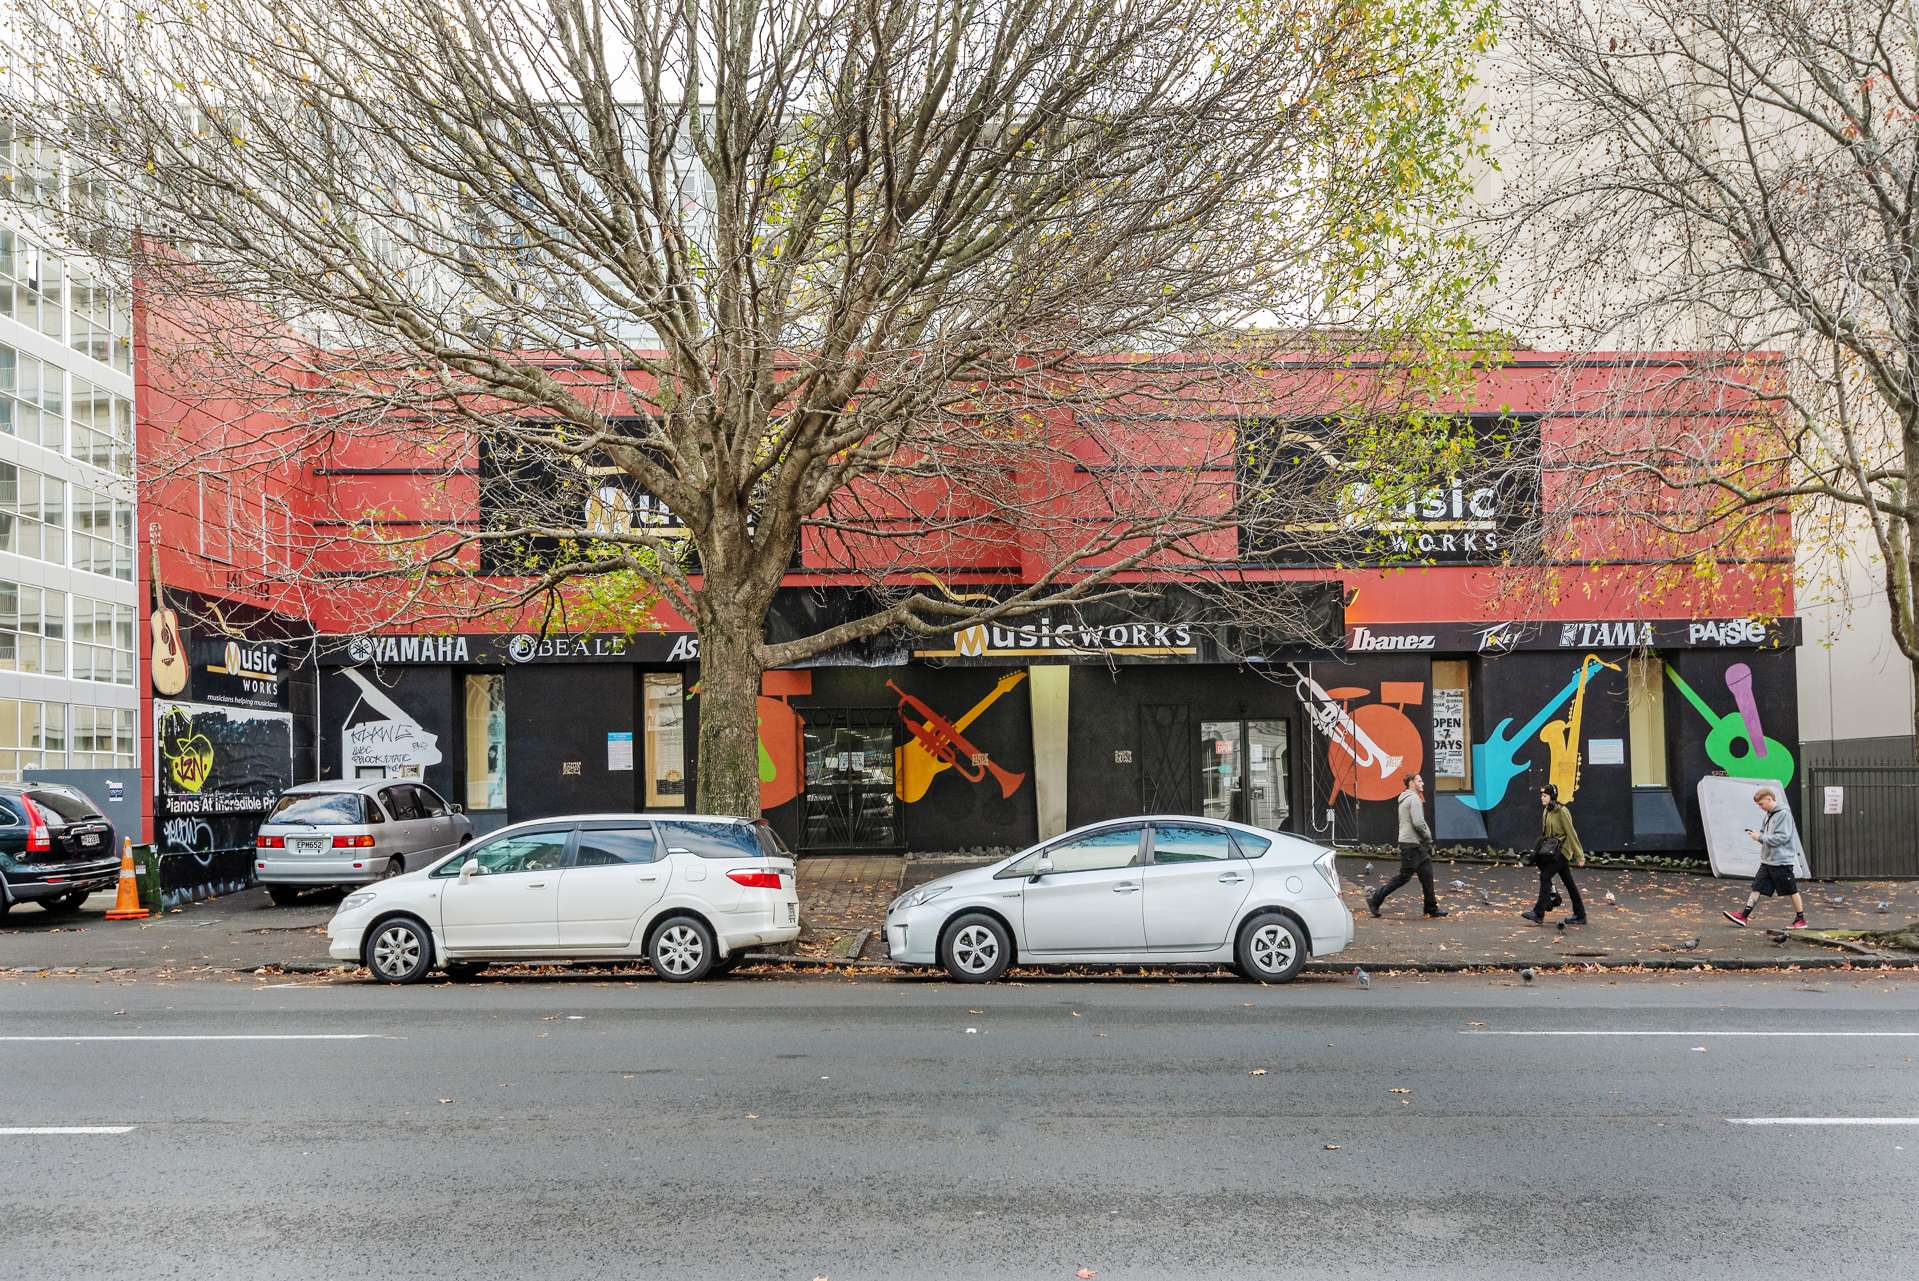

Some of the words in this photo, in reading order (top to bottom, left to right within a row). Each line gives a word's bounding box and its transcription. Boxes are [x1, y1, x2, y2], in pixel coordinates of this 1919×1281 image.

[1391, 533, 1498, 552] WORKS
[954, 617, 1074, 656] Music
[1079, 624, 1191, 647] WORKS
[1349, 627, 1436, 651] Ibanez
[1578, 622, 1654, 647] TAMA
[372, 636, 469, 662] YAMAHA
[537, 638, 626, 657] BEALE
[225, 641, 277, 675] Music
[243, 679, 278, 696] WORKS
[207, 694, 234, 703] musicians
[235, 697, 253, 707] helping
[254, 700, 278, 708] musicians
[1434, 717, 1461, 728] OPEN
[1434, 740, 1462, 750] DAYS
[201, 797, 213, 812] At
[296, 840, 322, 849] EPM652
